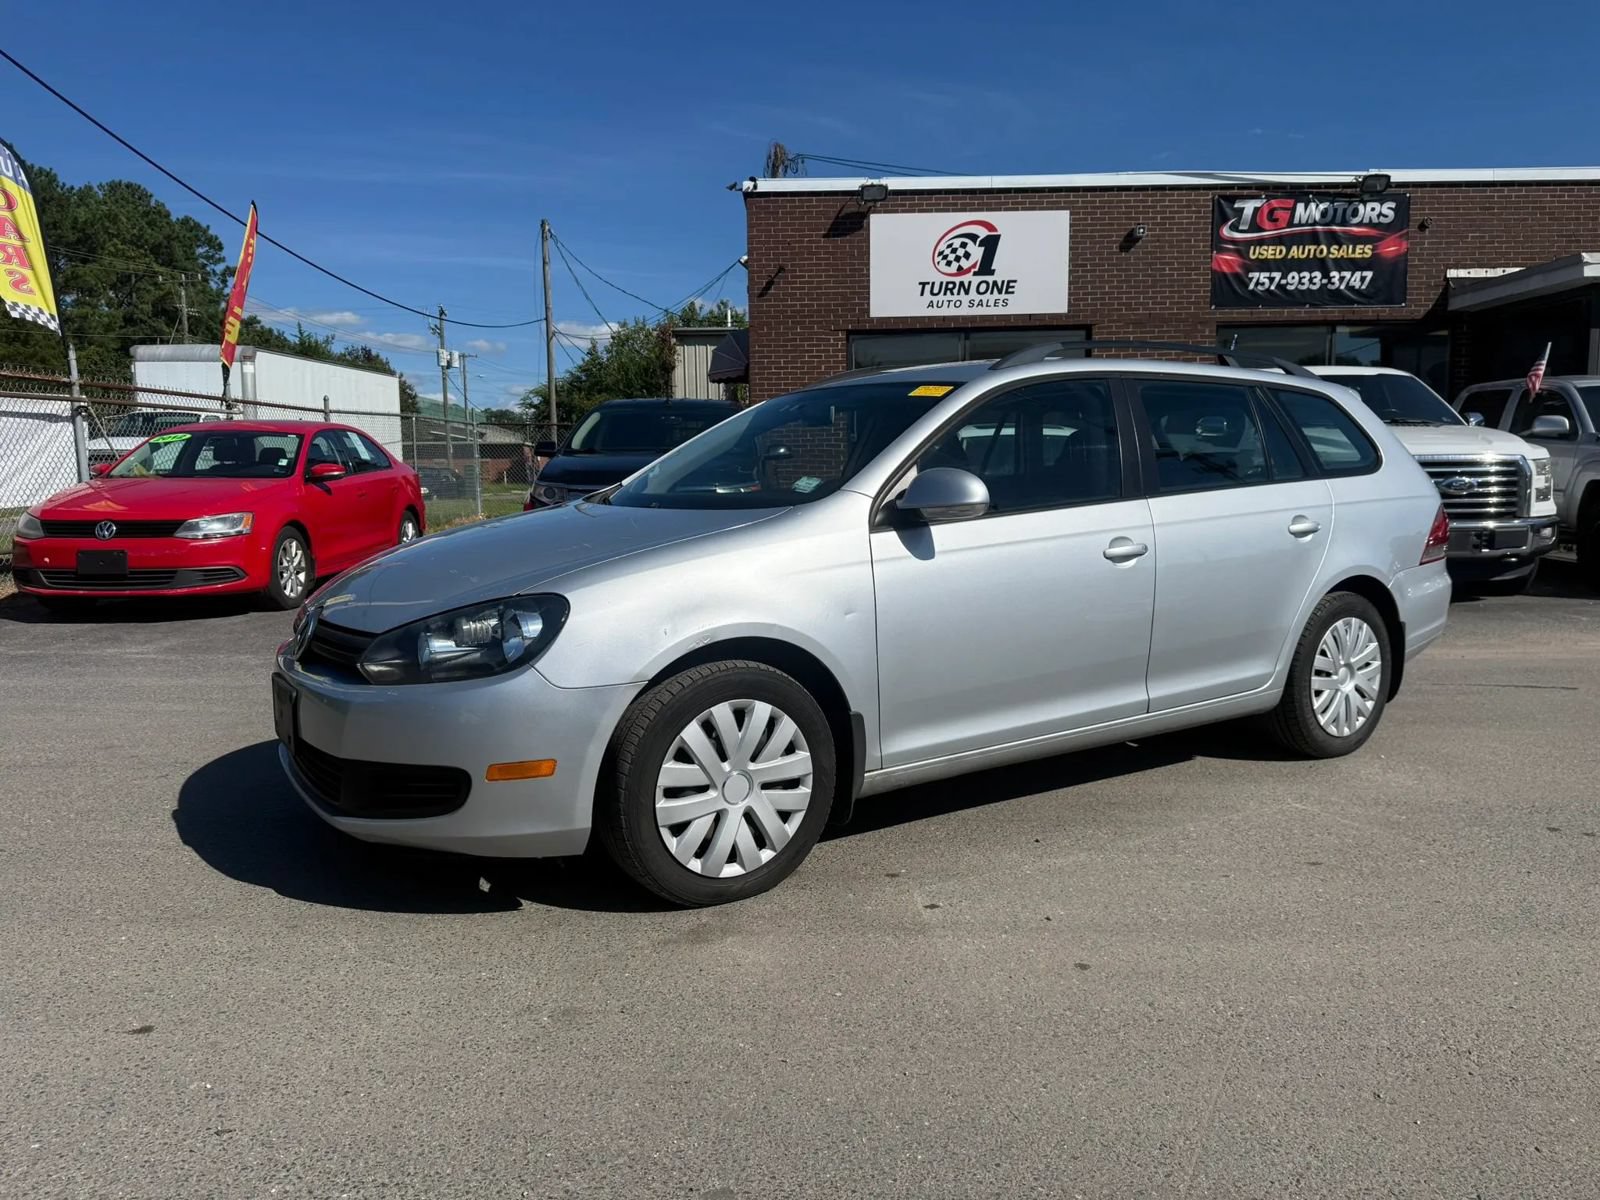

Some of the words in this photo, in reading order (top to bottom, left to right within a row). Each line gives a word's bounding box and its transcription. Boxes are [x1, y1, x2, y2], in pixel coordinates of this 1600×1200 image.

[1233, 199, 1294, 230] TG
[1293, 201, 1397, 225] MOTORS
[1249, 245, 1286, 260] USED
[1288, 245, 1328, 259] AUTO
[1328, 244, 1373, 259] SALES
[918, 280, 972, 297] TURN
[976, 280, 1017, 295] ONE
[1247, 271, 1373, 291] 757-933-3747
[926, 299, 963, 309] AUTO
[967, 298, 1009, 308] SALES
